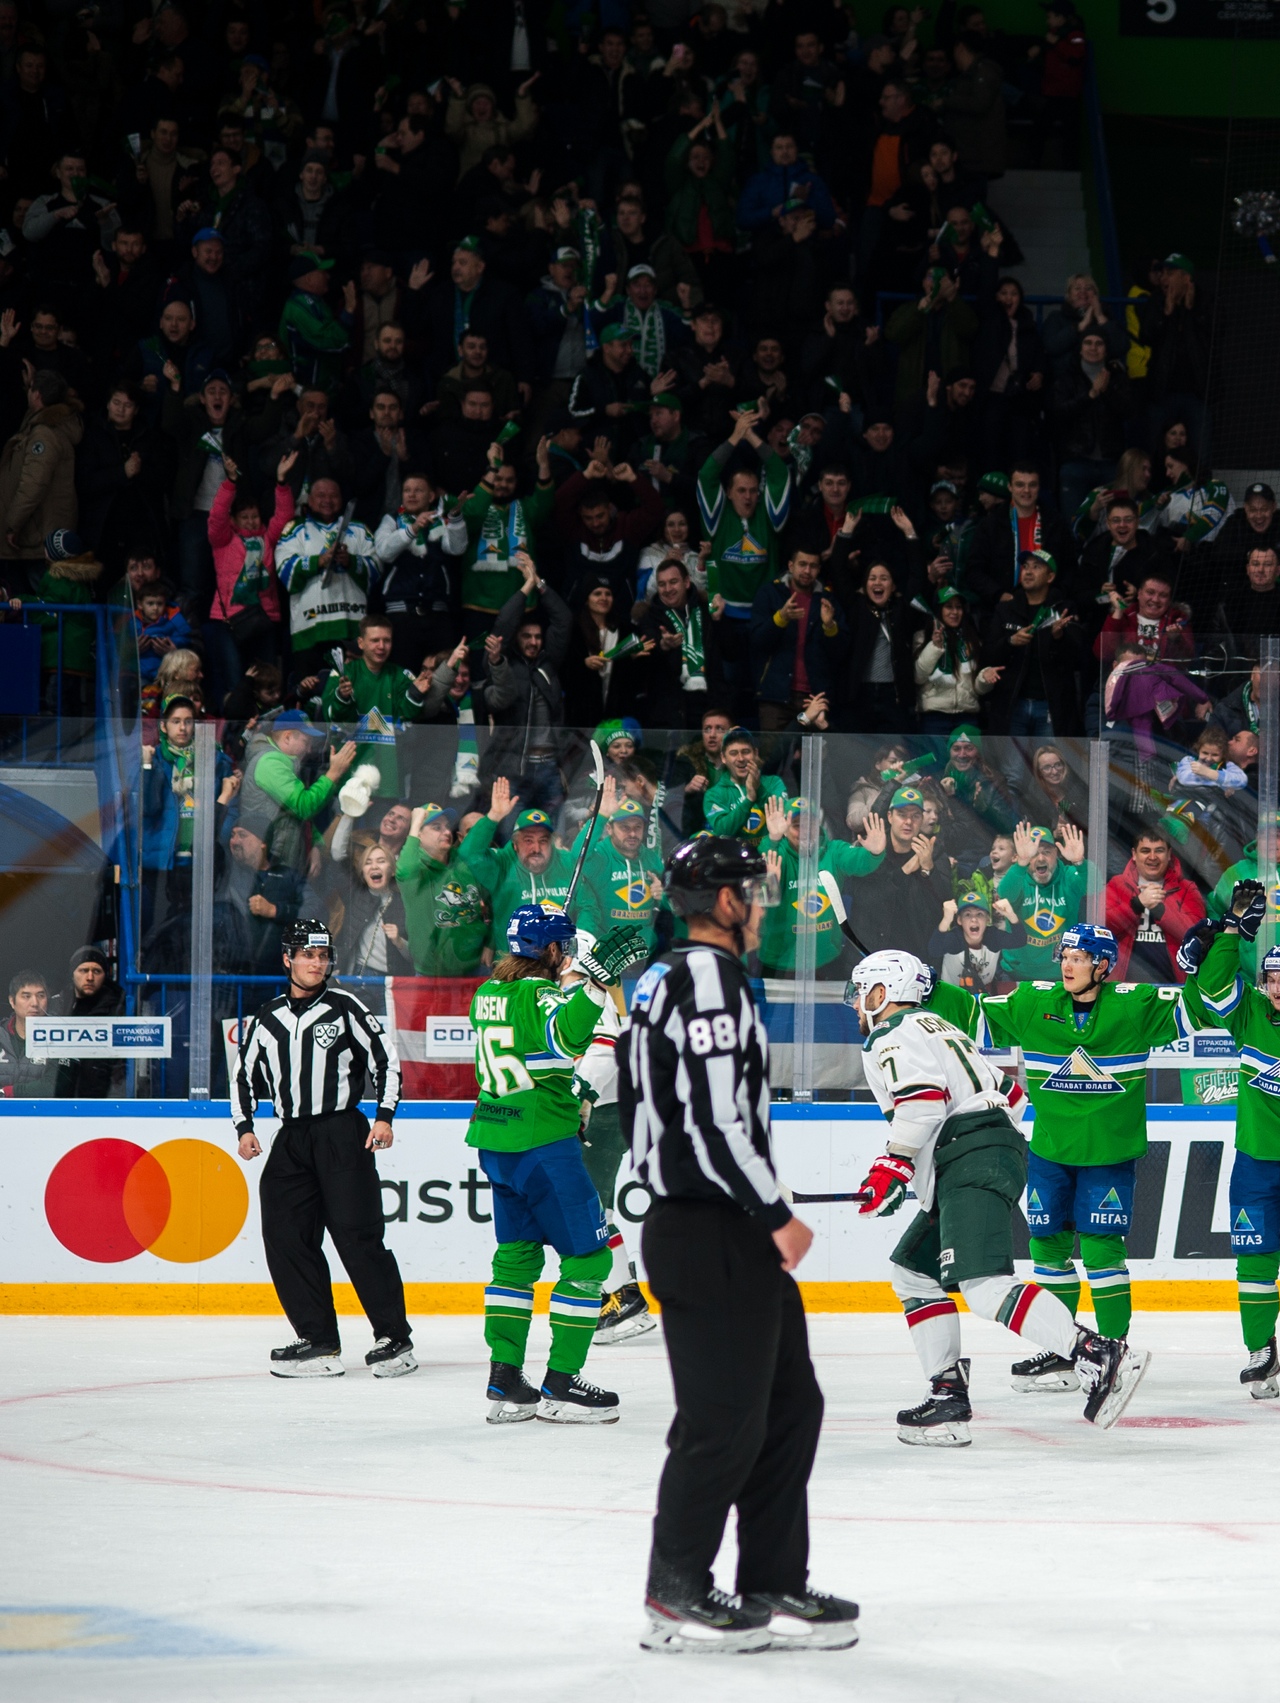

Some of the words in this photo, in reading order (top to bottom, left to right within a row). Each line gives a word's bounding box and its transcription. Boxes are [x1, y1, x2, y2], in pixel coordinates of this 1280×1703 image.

[1026, 932, 1062, 948] RAZILIANS
[33, 1028, 108, 1042] СОГАЗ
[116, 1028, 160, 1036] СТРАХОВАЯ
[123, 1035, 153, 1043] ГРУППА
[434, 1029, 477, 1041] СОГ
[688, 1014, 738, 1056] 88
[1051, 1081, 1083, 1091] САЛАВАТ
[1084, 1081, 1113, 1091] ЮЛАЕВ
[1027, 1213, 1050, 1226] ЕГАЗ
[1089, 1211, 1128, 1226] ПЕГАЗ
